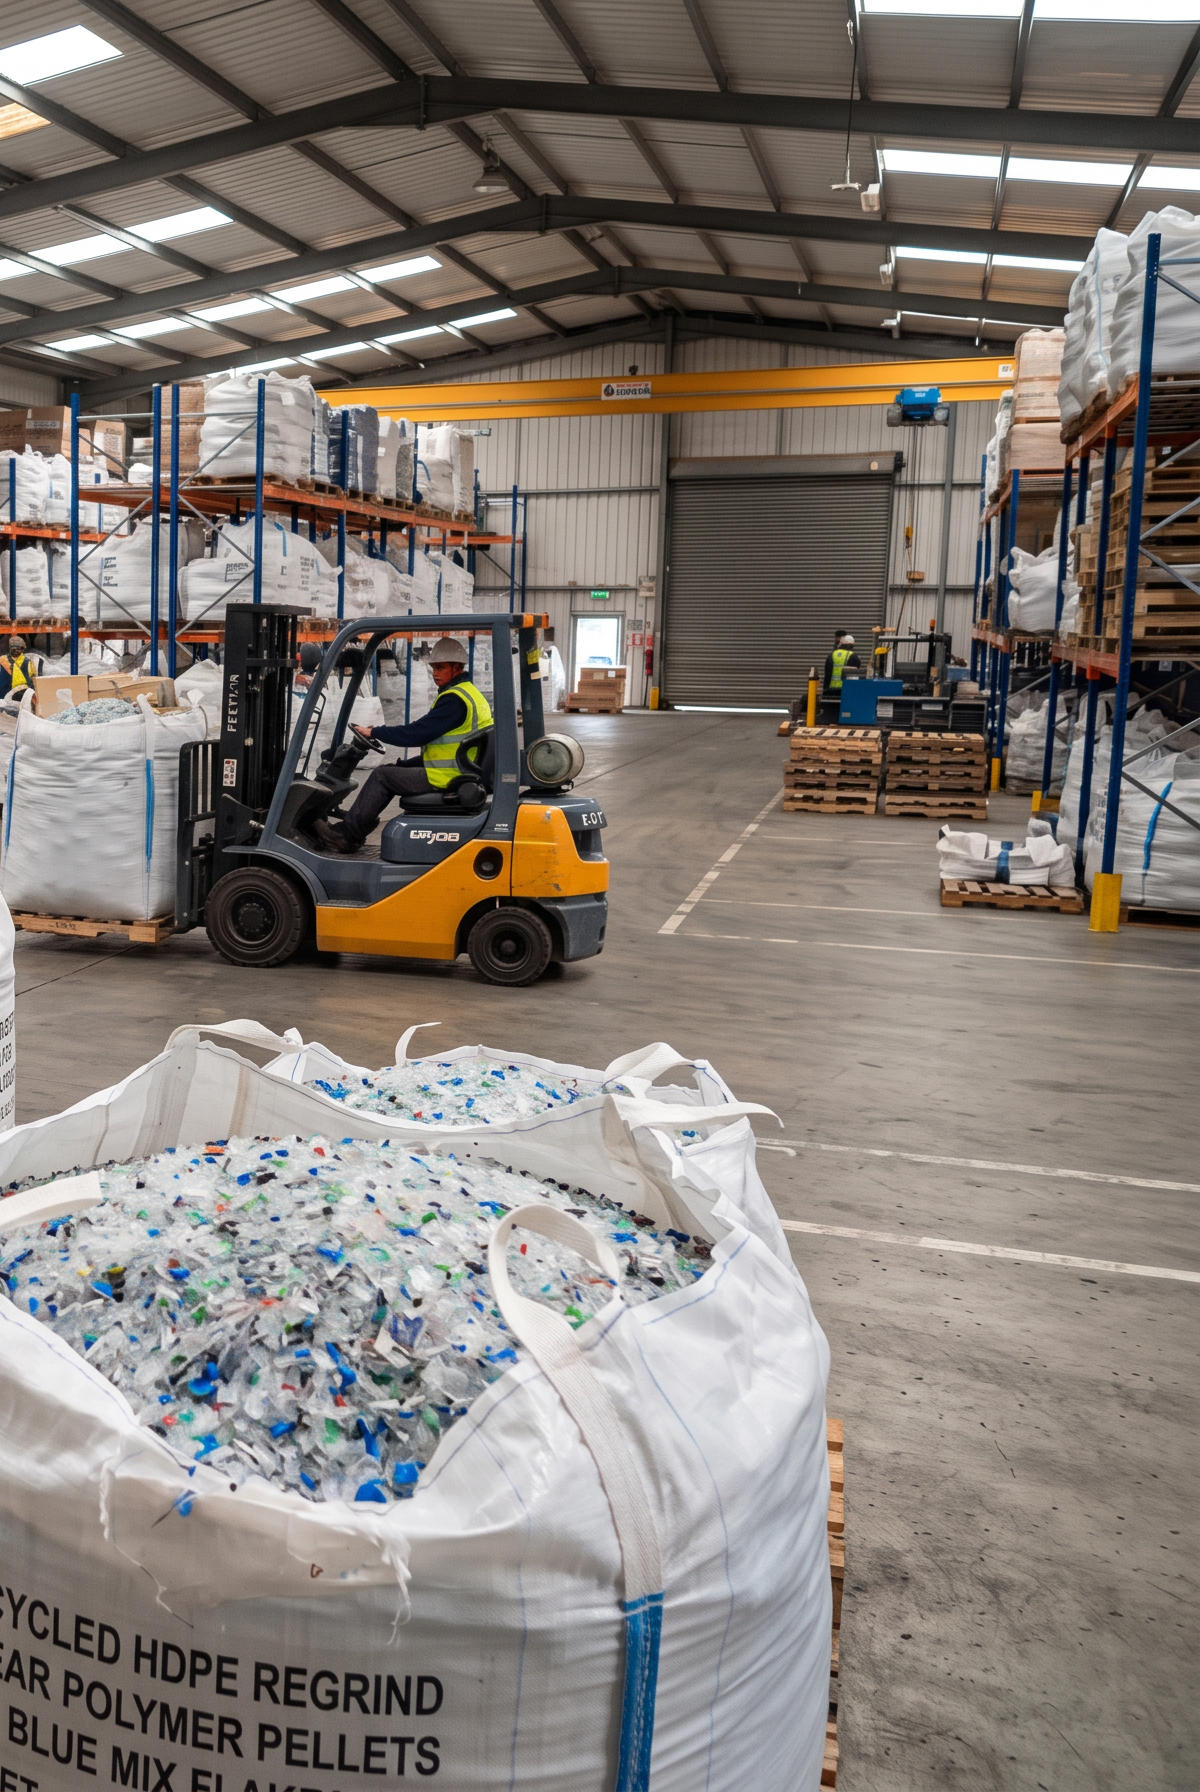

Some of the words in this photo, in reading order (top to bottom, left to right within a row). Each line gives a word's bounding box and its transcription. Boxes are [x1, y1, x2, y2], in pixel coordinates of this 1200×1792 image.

[134, 1634, 239, 1697] HDPE
[254, 1662, 444, 1716] REGRIND
[8, 1706, 97, 1776] BLUE
[111, 1745, 177, 1792] MIX
[62, 1674, 244, 1758] POLYMER
[257, 1722, 441, 1776] PELLETS
